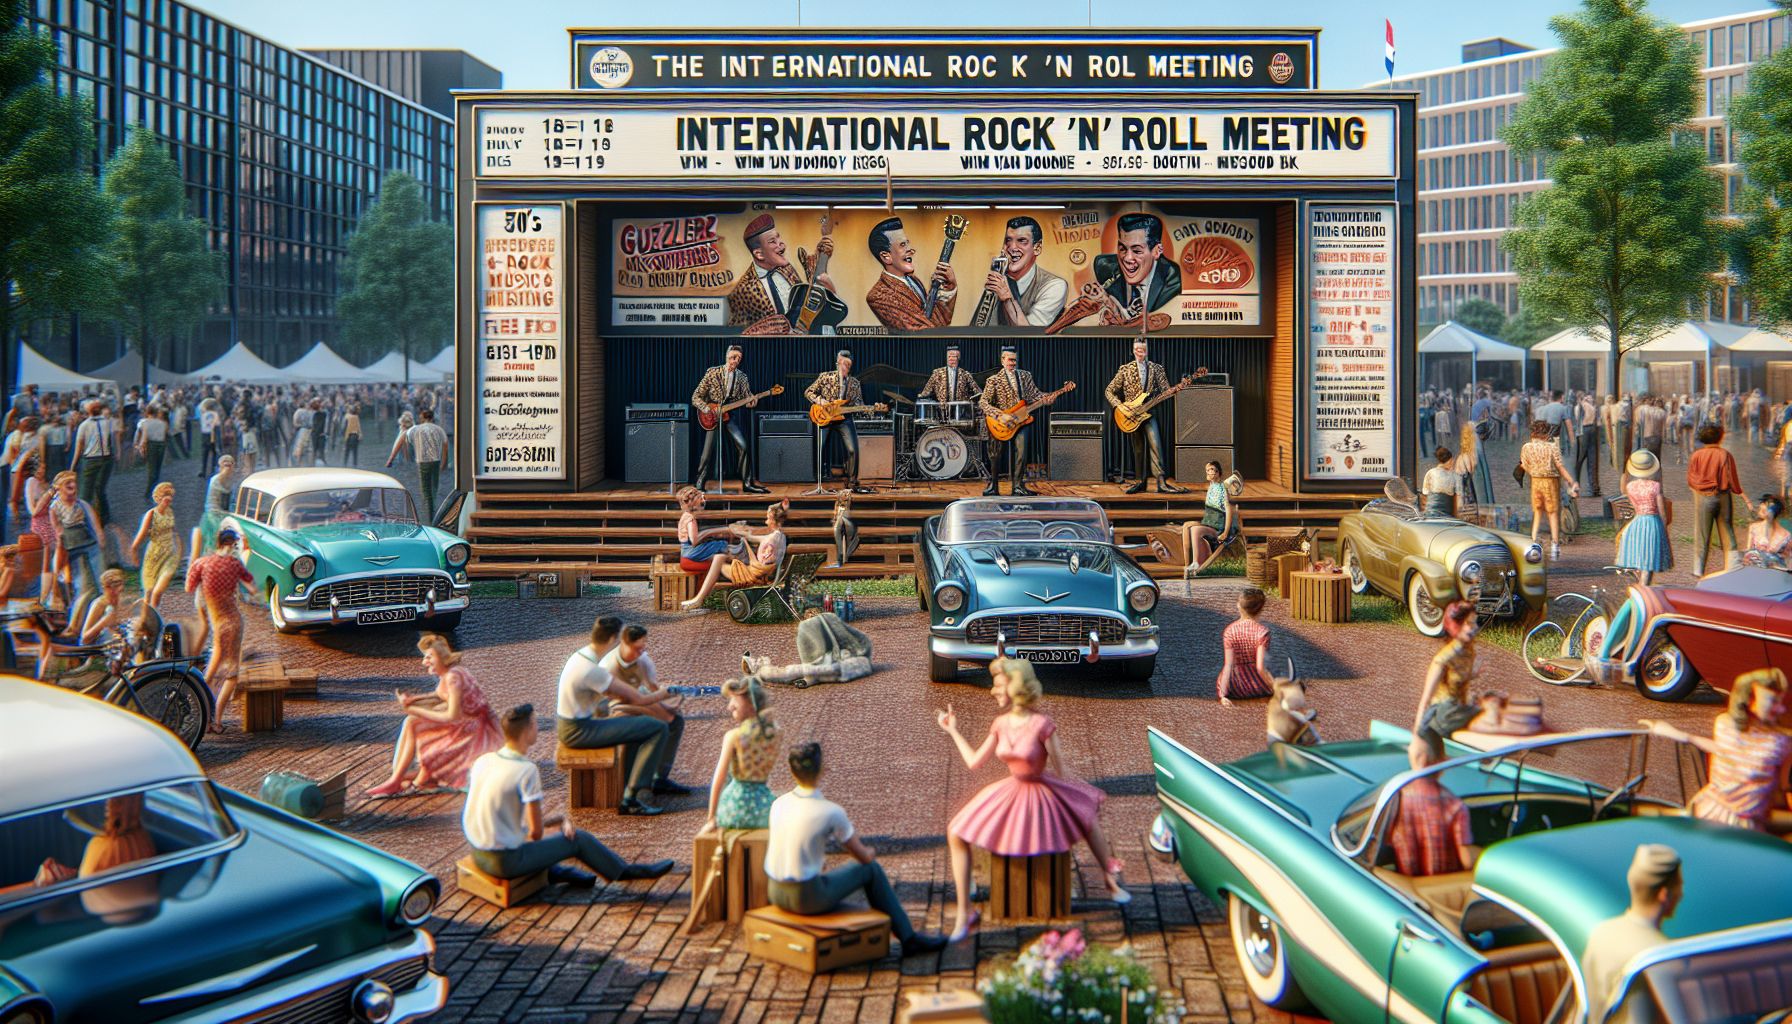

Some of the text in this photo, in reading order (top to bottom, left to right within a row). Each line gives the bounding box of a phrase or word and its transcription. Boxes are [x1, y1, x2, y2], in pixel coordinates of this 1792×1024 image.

[652, 55, 704, 78] THE
[1045, 55, 1073, 78] 'N
[1088, 55, 1136, 78] ROL
[1148, 54, 1254, 78] MEETING
[677, 117, 1367, 151] INTERNATIONAL ROCK 'N' ROLL MEETING
